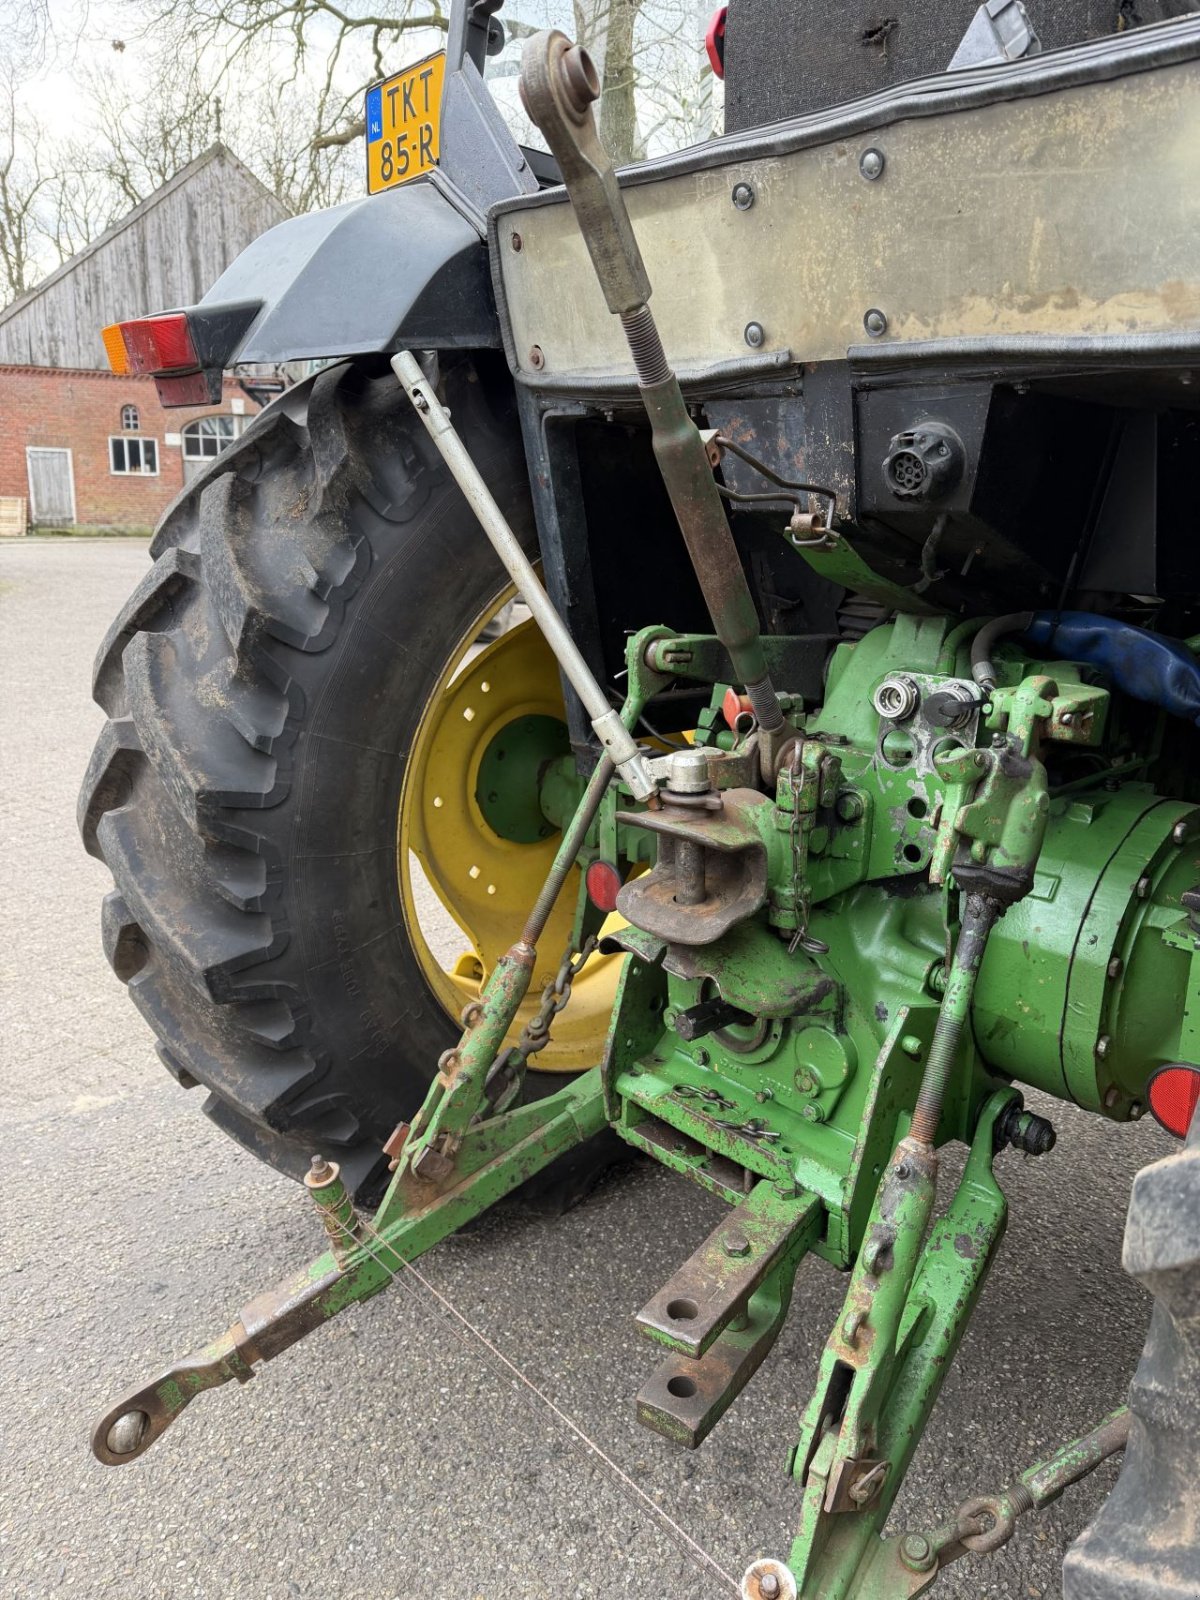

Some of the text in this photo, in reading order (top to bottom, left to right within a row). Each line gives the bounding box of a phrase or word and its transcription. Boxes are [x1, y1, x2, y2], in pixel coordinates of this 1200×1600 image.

[387, 67, 433, 128] TKT
[371, 122, 381, 134] NL
[381, 123, 435, 182] 85-R
